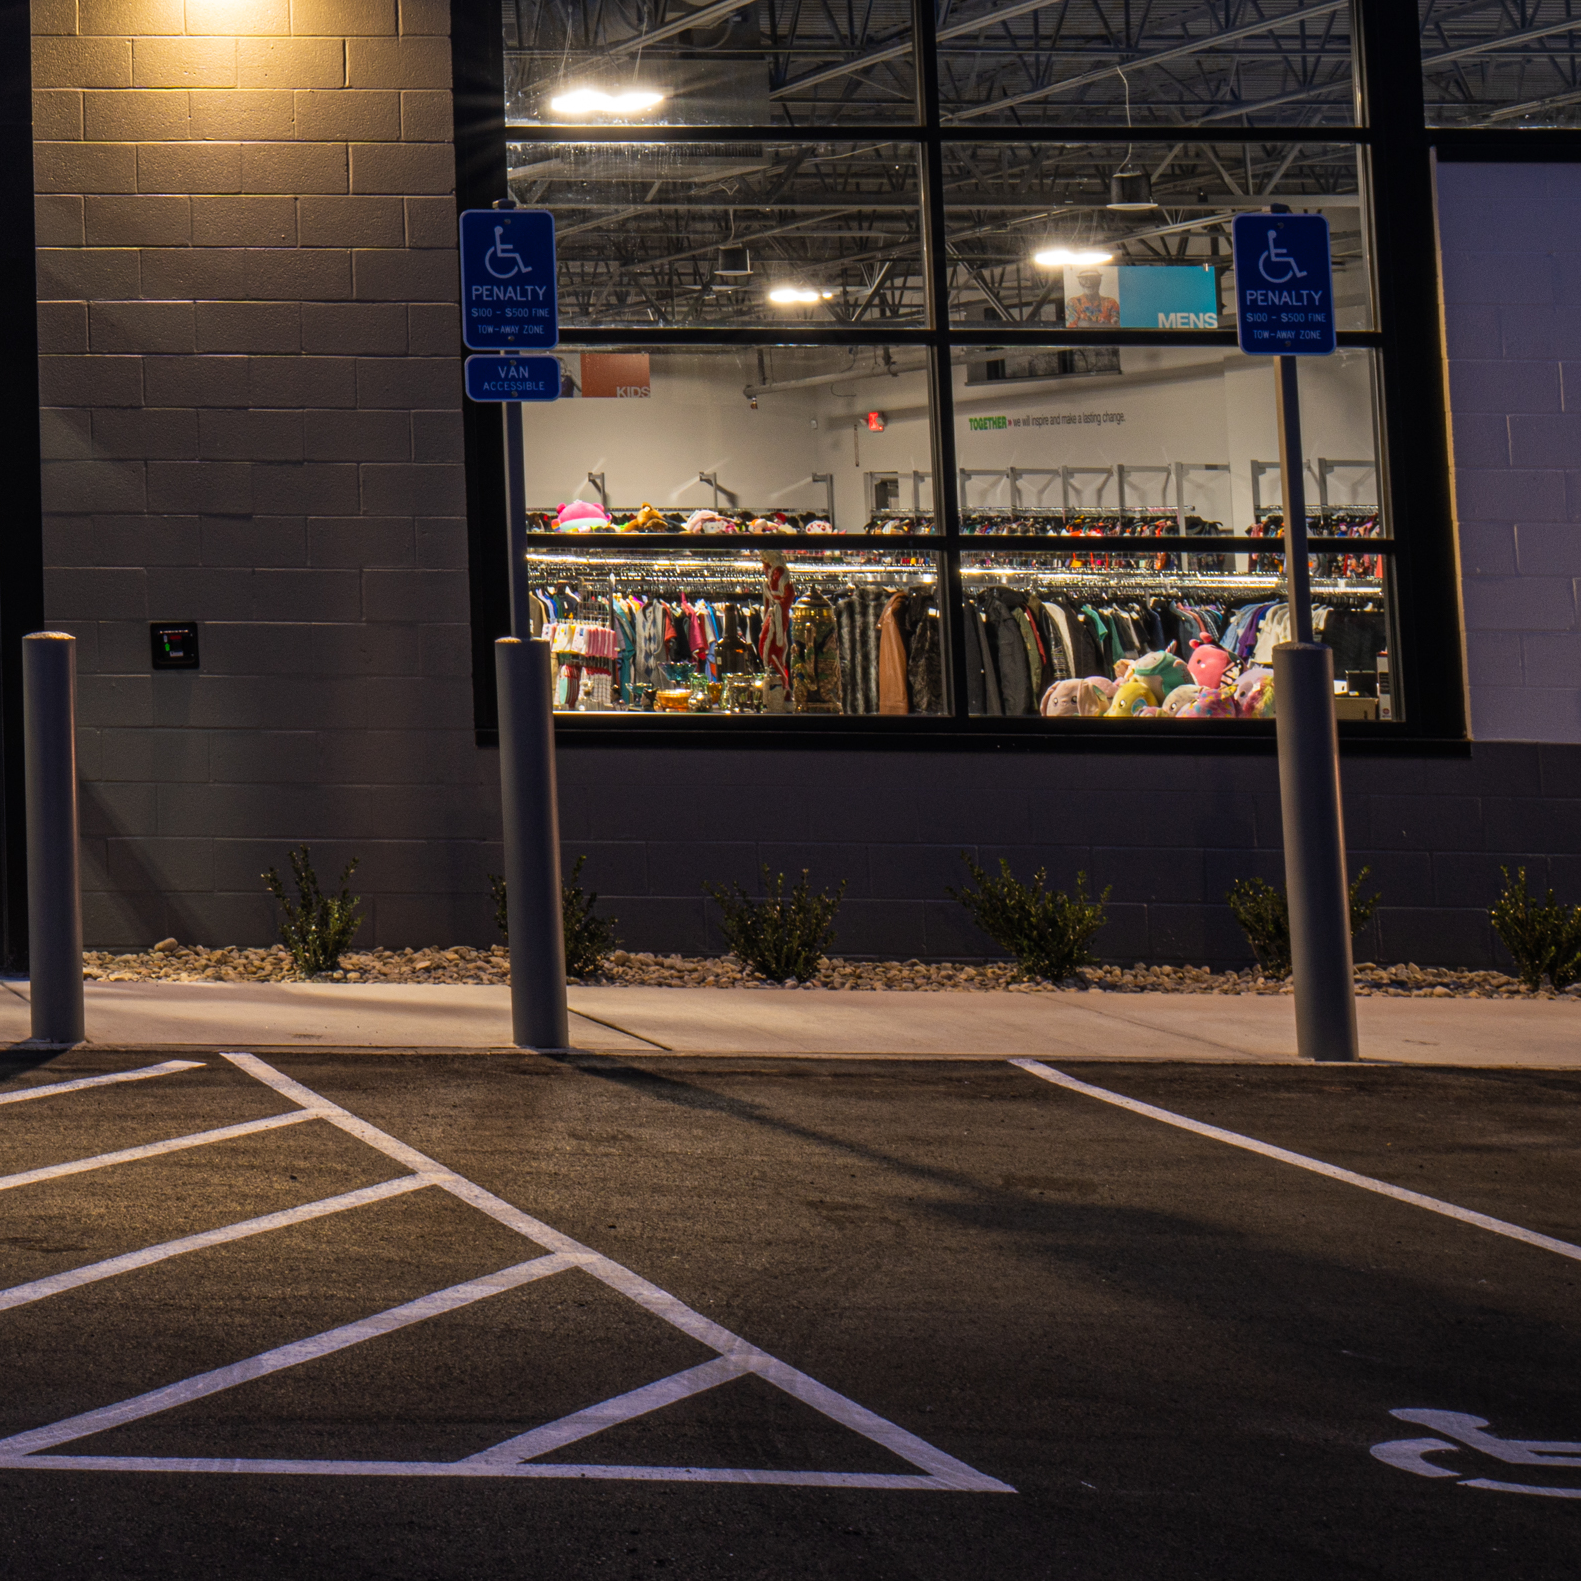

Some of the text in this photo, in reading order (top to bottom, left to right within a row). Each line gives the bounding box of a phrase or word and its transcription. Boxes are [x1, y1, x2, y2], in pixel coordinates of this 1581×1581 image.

[472, 286, 547, 301] PENALTY
[1246, 290, 1323, 306] PENALTY
[471, 308, 492, 317] $100
[505, 308, 529, 317] $500
[532, 308, 550, 317] FINE
[1246, 313, 1268, 323] $100
[1281, 313, 1305, 323] $500
[1308, 313, 1327, 323] FINE
[1158, 312, 1218, 328] MENS
[478, 325, 545, 334] TOW-AWAY ZONE
[1253, 329, 1321, 339] TOW-AWAY ZONE
[498, 366, 529, 378] VAN
[483, 382, 545, 391] ACCESSIBLE
[616, 386, 650, 398] KIDS
[969, 415, 1007, 430] TOGETHER
[1050, 413, 1060, 425] and
